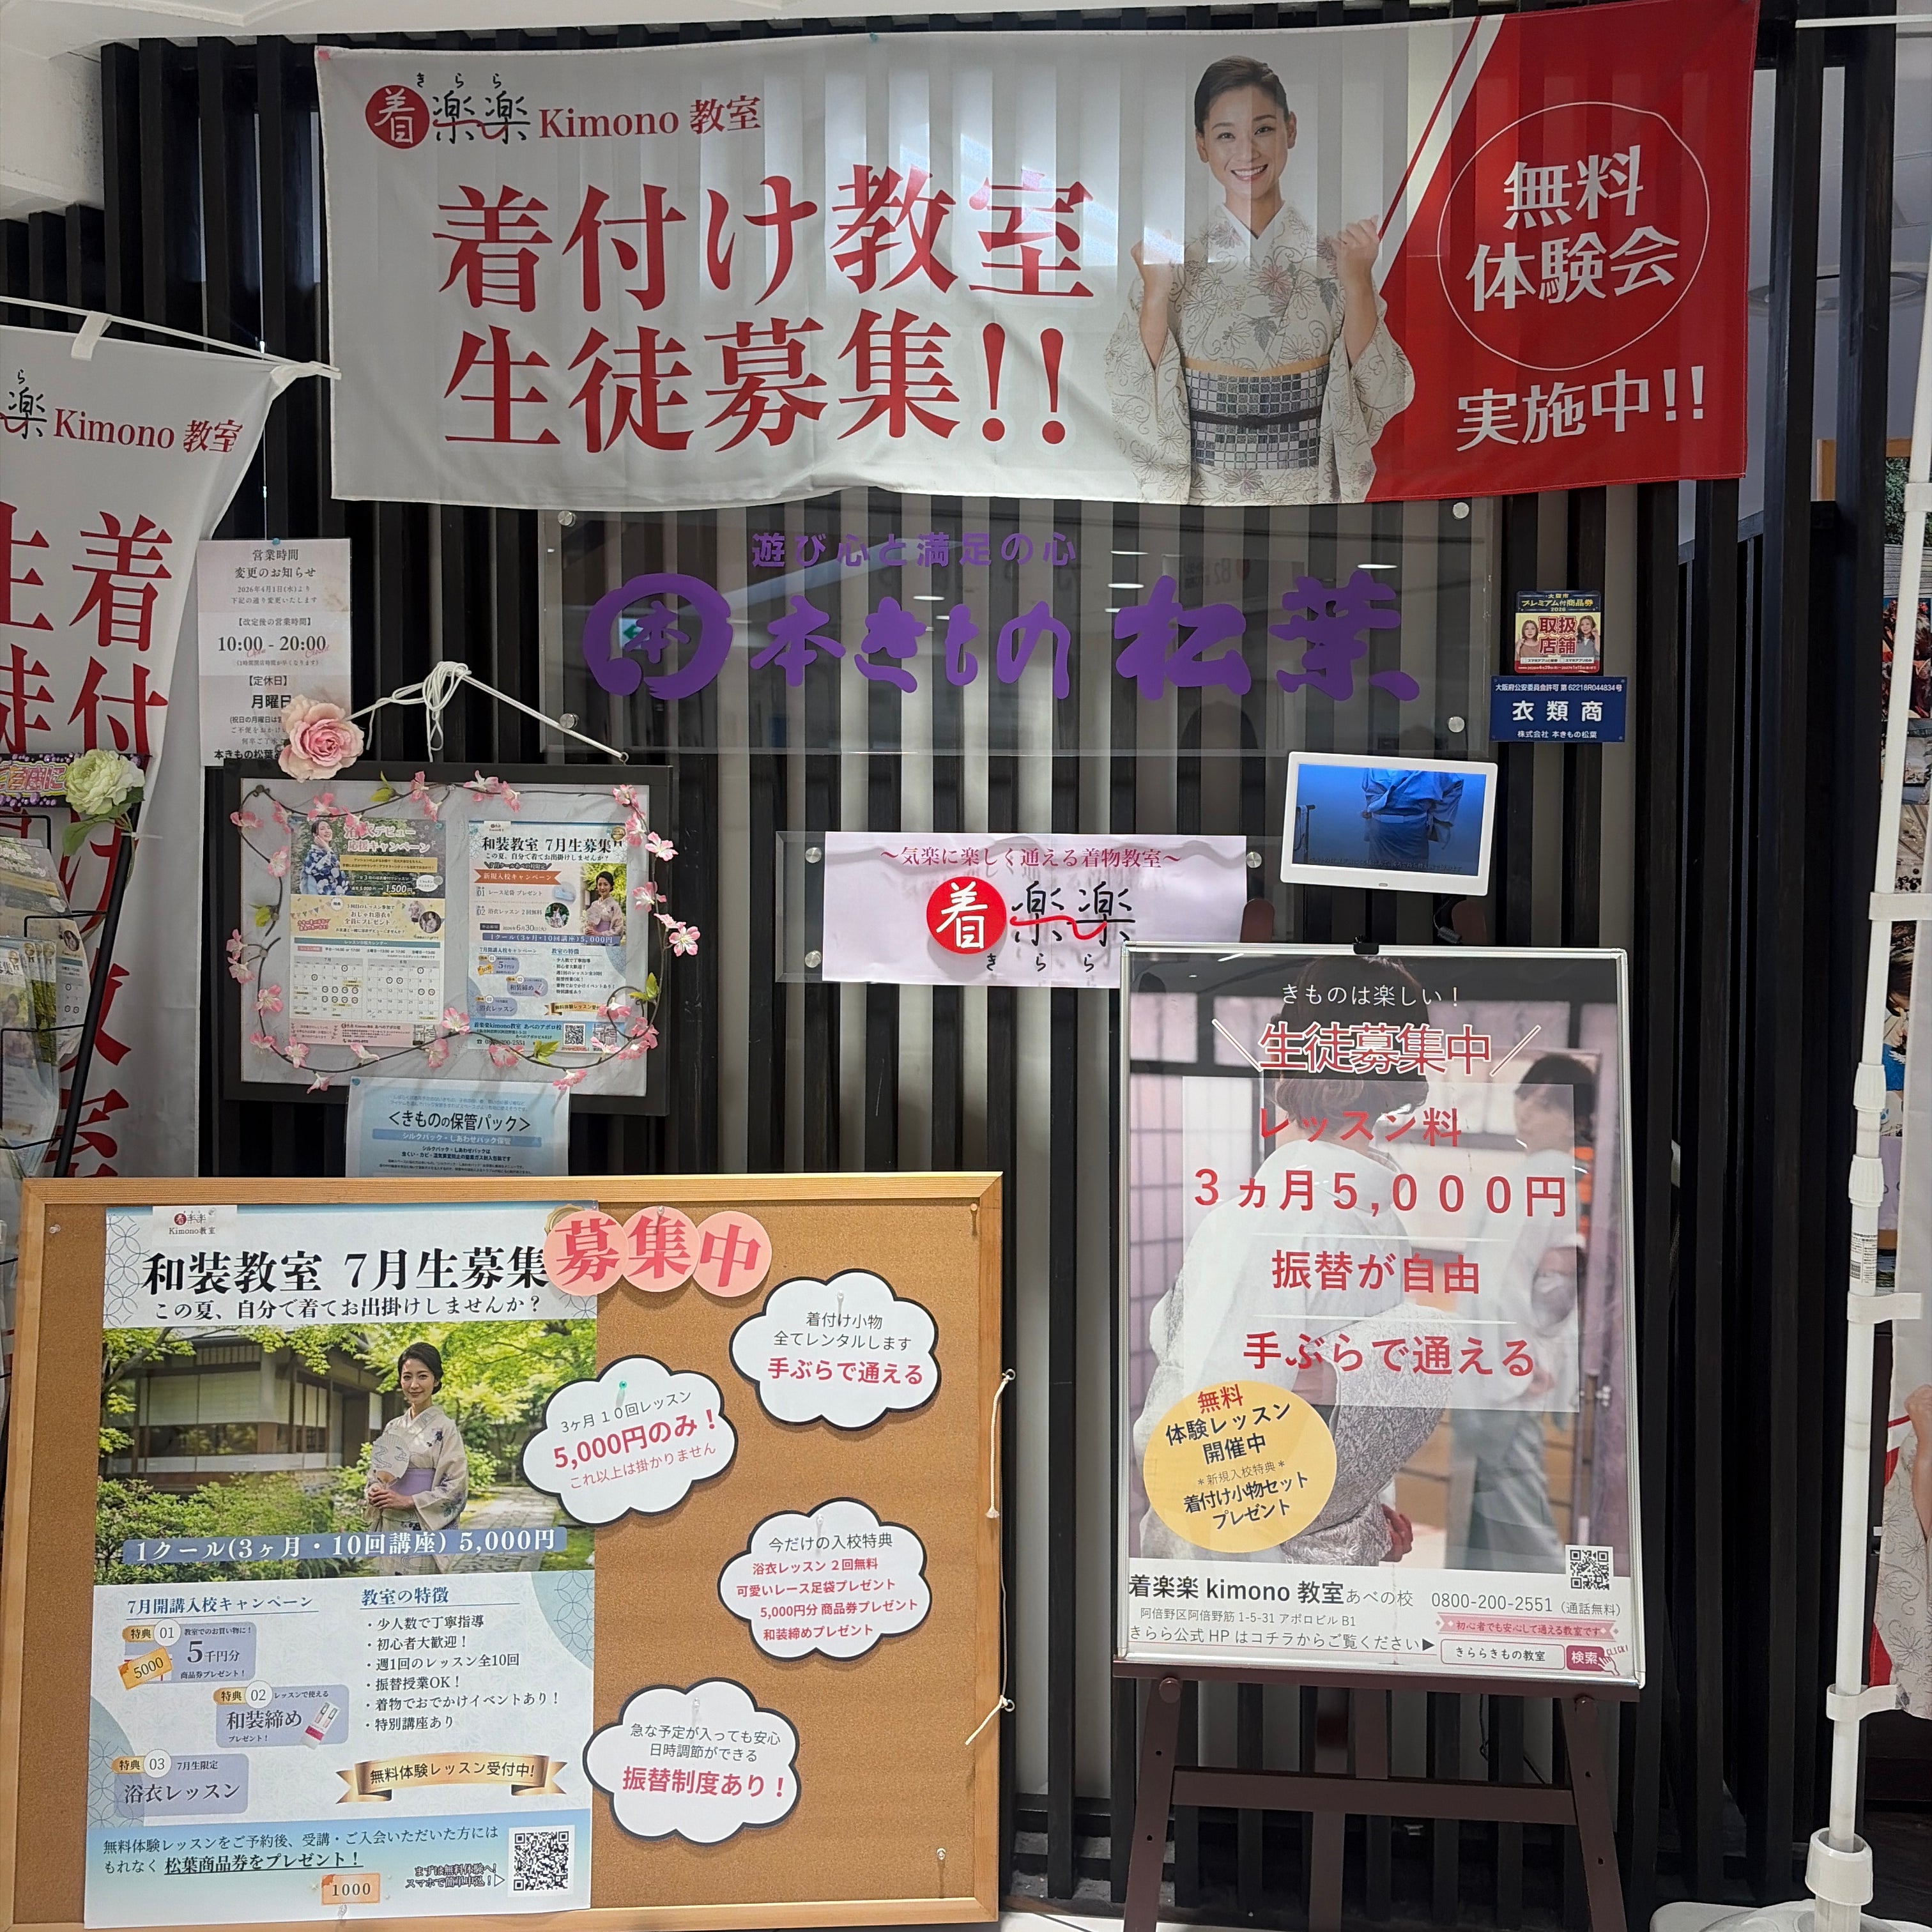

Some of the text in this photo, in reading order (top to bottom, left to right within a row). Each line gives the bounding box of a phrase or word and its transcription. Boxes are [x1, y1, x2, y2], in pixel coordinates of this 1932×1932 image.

[416, 72, 503, 89] きらら
[539, 107, 679, 139] Kimono
[689, 95, 762, 135] 教室
[1503, 144, 1644, 231] 無料
[433, 164, 1094, 312] 着付け教室
[1465, 225, 1680, 312] 体験会
[443, 308, 1066, 454] 生徒募集!!
[1456, 365, 1705, 452] 実施中!!
[53, 408, 176, 450] Kimono
[183, 418, 244, 454] 教室
[252, 548, 300, 562] 営業時間
[752, 532, 1076, 568] 遊び心と満足の心
[234, 567, 317, 579] 変更のお知らせ
[749, 570, 1420, 701] 本きもの松葉
[1538, 615, 1577, 634] 取扱
[218, 636, 326, 652] 10:00 20:00
[1538, 636, 1577, 655] 店舗
[249, 675, 288, 687] 【定休日】
[251, 694, 292, 709] 月曜日
[1512, 700, 1603, 722] 衣類商
[1517, 730, 1597, 739] 株式会社 本きもの松葉
[481, 836, 539, 852] 和装教室
[483, 871, 552, 881] 新規入校キャンペーン
[986, 953, 1095, 973] きらら
[1282, 983, 1460, 1008] きものは楽しい！
[1257, 1021, 1492, 1077] 生徒募集中
[1260, 1107, 1462, 1147] レッスン料
[554, 1215, 762, 1287] 募集中
[141, 1246, 551, 1296] 和装教室 7月生募集
[1272, 1249, 1480, 1295] 振替が自由
[155, 1294, 540, 1321] この夏、自分で着てお出掛けしませんか？
[806, 1311, 883, 1330] 着付け小物
[774, 1330, 912, 1351] 全てレンタルします
[1243, 1330, 1534, 1377] 手ぶらで通える
[767, 1356, 923, 1385] 手ぶらで通える
[1197, 1383, 1243, 1414] 無料
[1165, 1403, 1291, 1447] 体験レッスン
[553, 1409, 716, 1471] 5,000円のみ！
[1202, 1432, 1266, 1465] 開催中
[570, 1443, 716, 1489] これ以上は掛かりません
[1183, 1471, 1308, 1514] 着付け小物セット
[1212, 1498, 1291, 1530] プレゼント
[459, 1529, 555, 1553] 5,000円
[768, 1532, 893, 1554] 今だけの入校特典
[736, 1578, 896, 1598] 可愛いレース足袋プレゼント
[1128, 1574, 1199, 1599] 着楽楽
[1206, 1578, 1291, 1602] kimono
[127, 1586, 449, 1615] 7月開講入校キャンペーン 教室の特徴
[760, 1598, 919, 1620] 5,000円分 商品券プレゼント
[1431, 1592, 1621, 1617] 0800-200-2551 (通話無料)
[1140, 1607, 1356, 1627] 阿倍野区阿倍野筋 1-5-31 アポロビル B1
[1455, 1619, 1601, 1637] 初心者でも安心して通える教室です
[130, 1626, 252, 1639] 特典 01 教室でのお買い物に！
[762, 1624, 873, 1642] 和装締めプレゼント
[1130, 1625, 1420, 1652] きらら公式 HP はコチラからご覧ください
[187, 1639, 241, 1664] 5千円分
[1455, 1646, 1546, 1662] きららきもの教室
[1570, 1650, 1598, 1666] 検索
[133, 1657, 165, 1680] 5000
[180, 1669, 246, 1680] 商品券プレゼント！
[220, 1688, 330, 1702] 特典 02 レッスンで使える
[226, 1708, 303, 1731] 和装締め
[227, 1734, 269, 1744] プレゼント！
[629, 1722, 781, 1746] 急な予定が入っても安心
[649, 1742, 758, 1763] 日時調節ができる
[119, 1758, 219, 1772] 特典 03 7月生限定
[369, 1761, 535, 1785] 無料体験レッスン受付中!
[124, 1782, 241, 1805] 浴衣レッスン
[622, 1765, 785, 1798] 振替制度あり！
[103, 1825, 500, 1855] 無料体験レッスンをご予約後、受講・ご入会いただいた方には
[103, 1851, 358, 1875] もれなく 松葉商品券をプレゼント！
[332, 1882, 372, 1897] 1000
